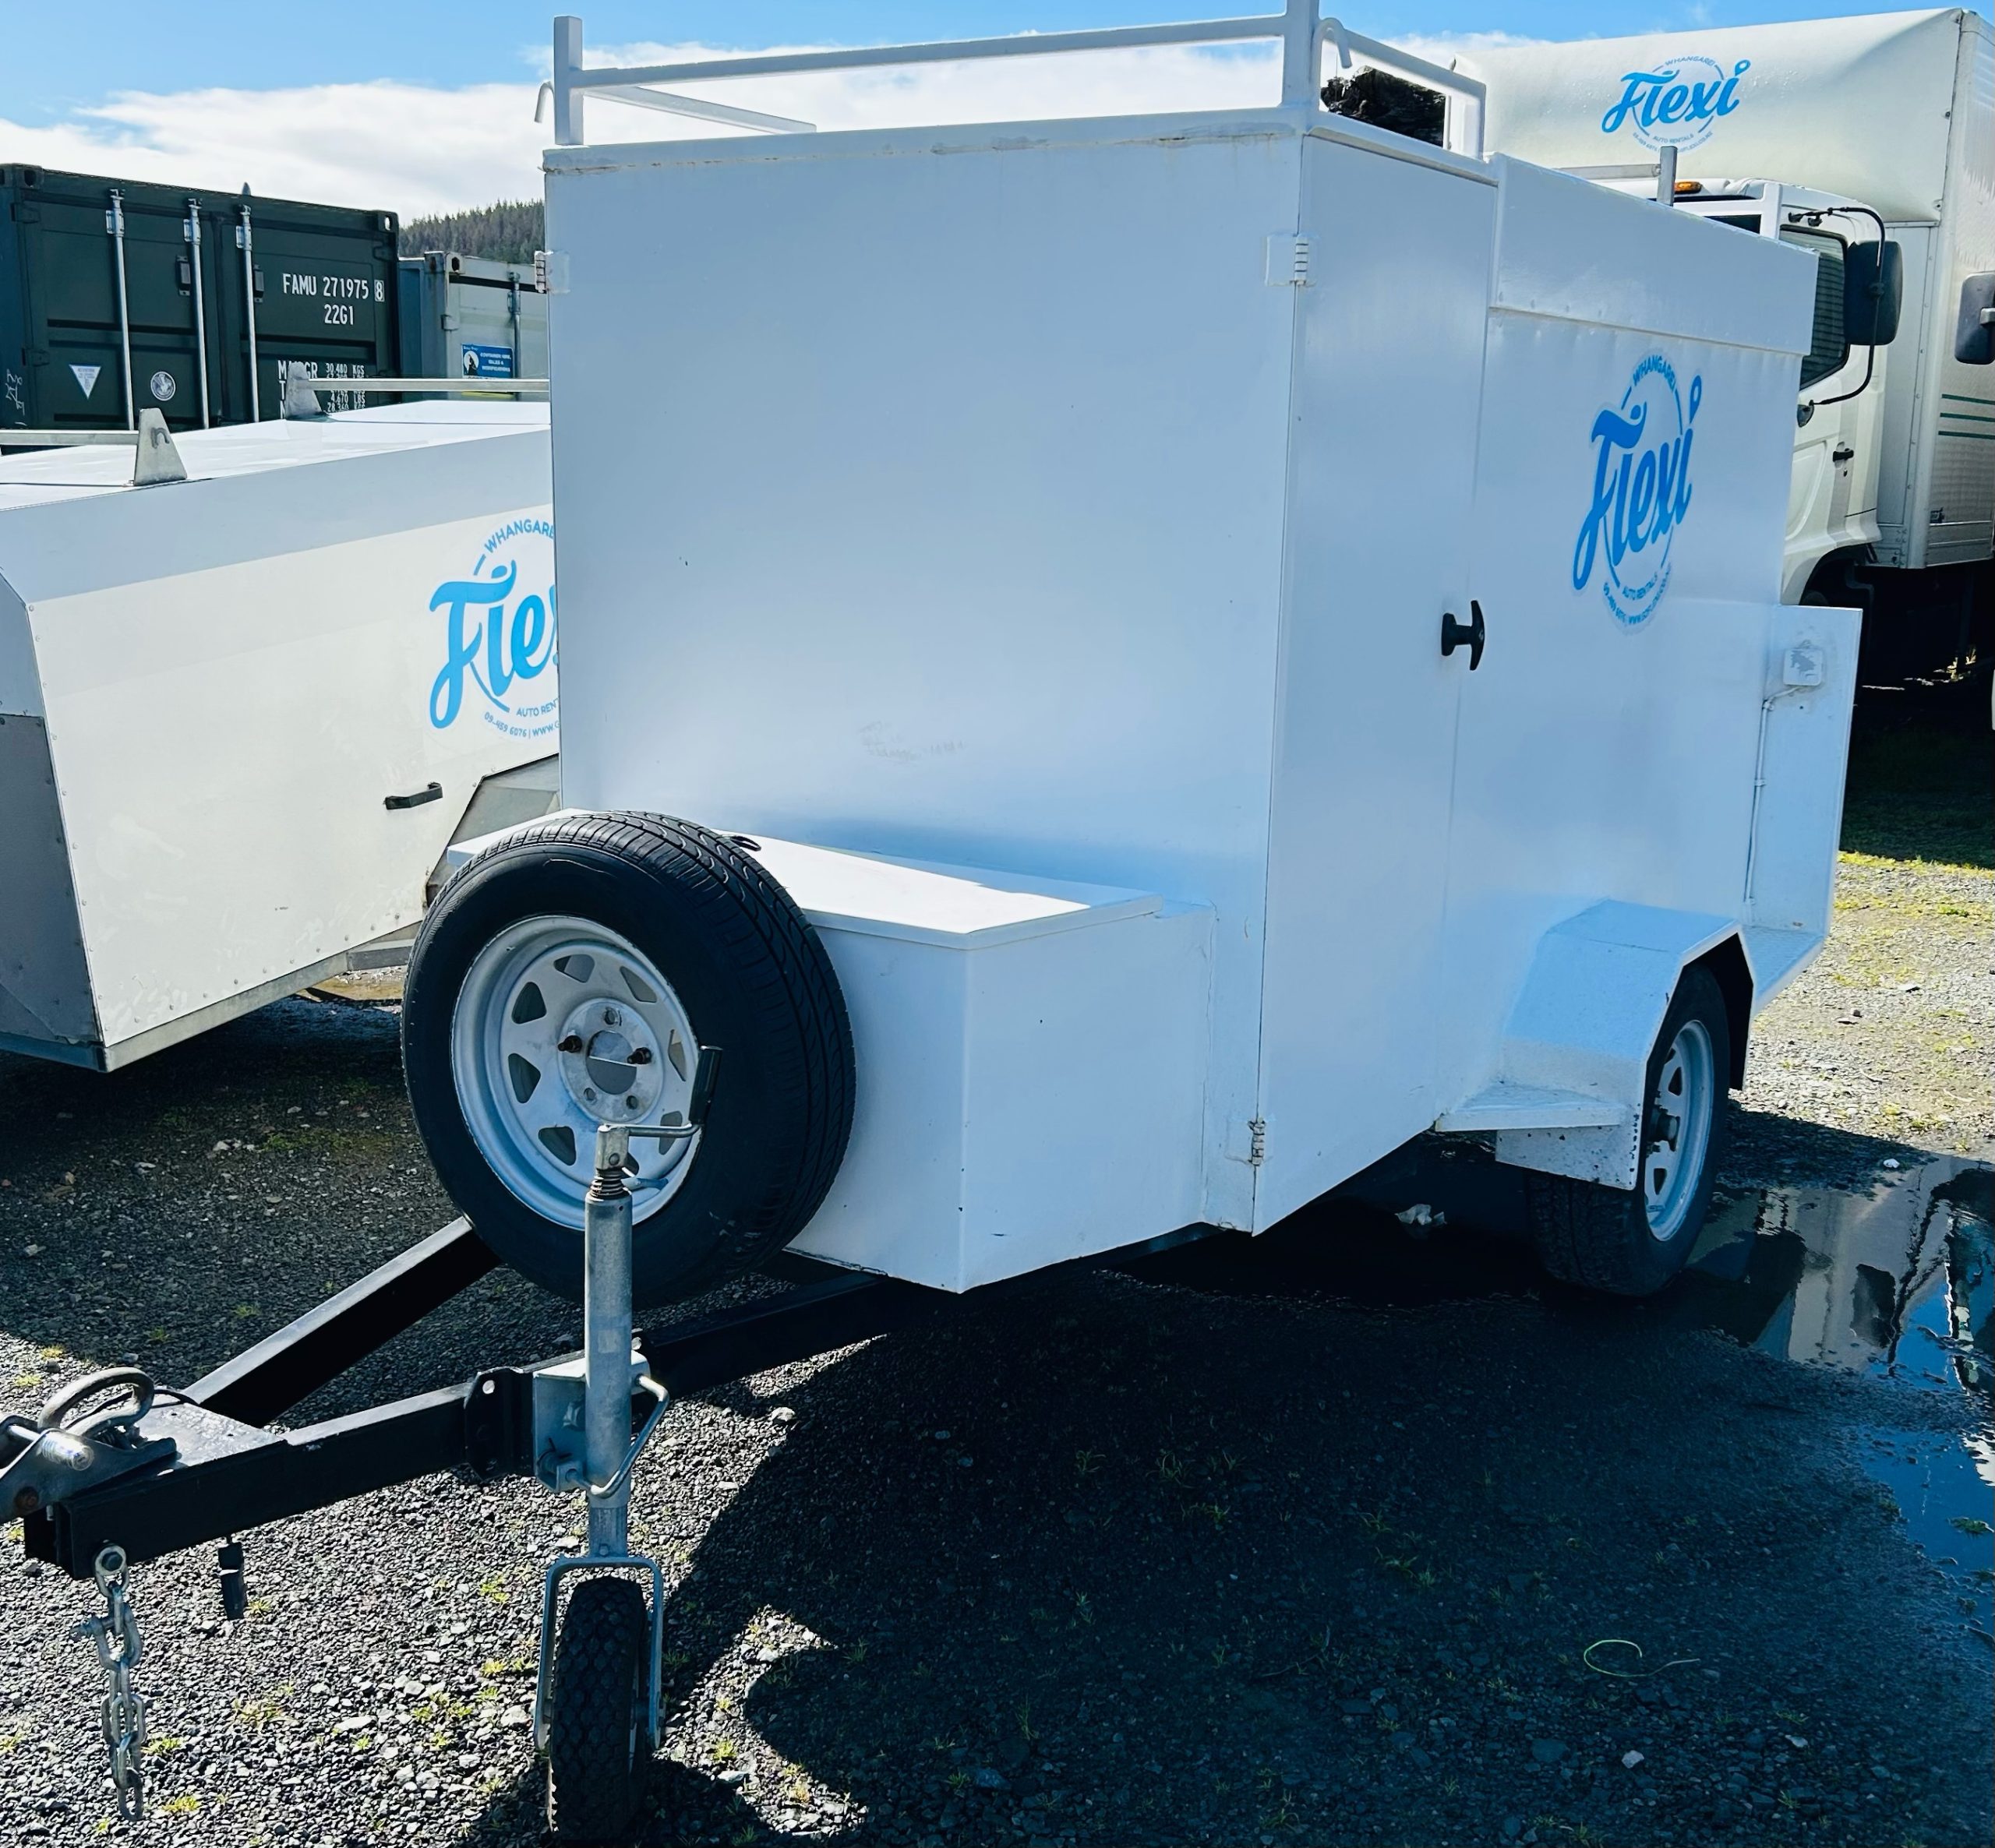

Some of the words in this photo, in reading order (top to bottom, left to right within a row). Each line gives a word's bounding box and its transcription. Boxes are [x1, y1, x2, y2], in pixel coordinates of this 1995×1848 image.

[1601, 59, 1751, 132] Flexi
[283, 273, 316, 295] FAMU
[323, 276, 369, 300] 271975
[375, 280, 384, 302] 8
[324, 303, 354, 326] 22G1
[352, 364, 365, 376] KGS
[1573, 375, 1702, 590] Flexi
[484, 519, 555, 553] WHANGARE
[516, 707, 539, 718] AUTO
[541, 697, 559, 714] RENT
[509, 726, 527, 738] 6076
[532, 720, 560, 737] WWW.G
